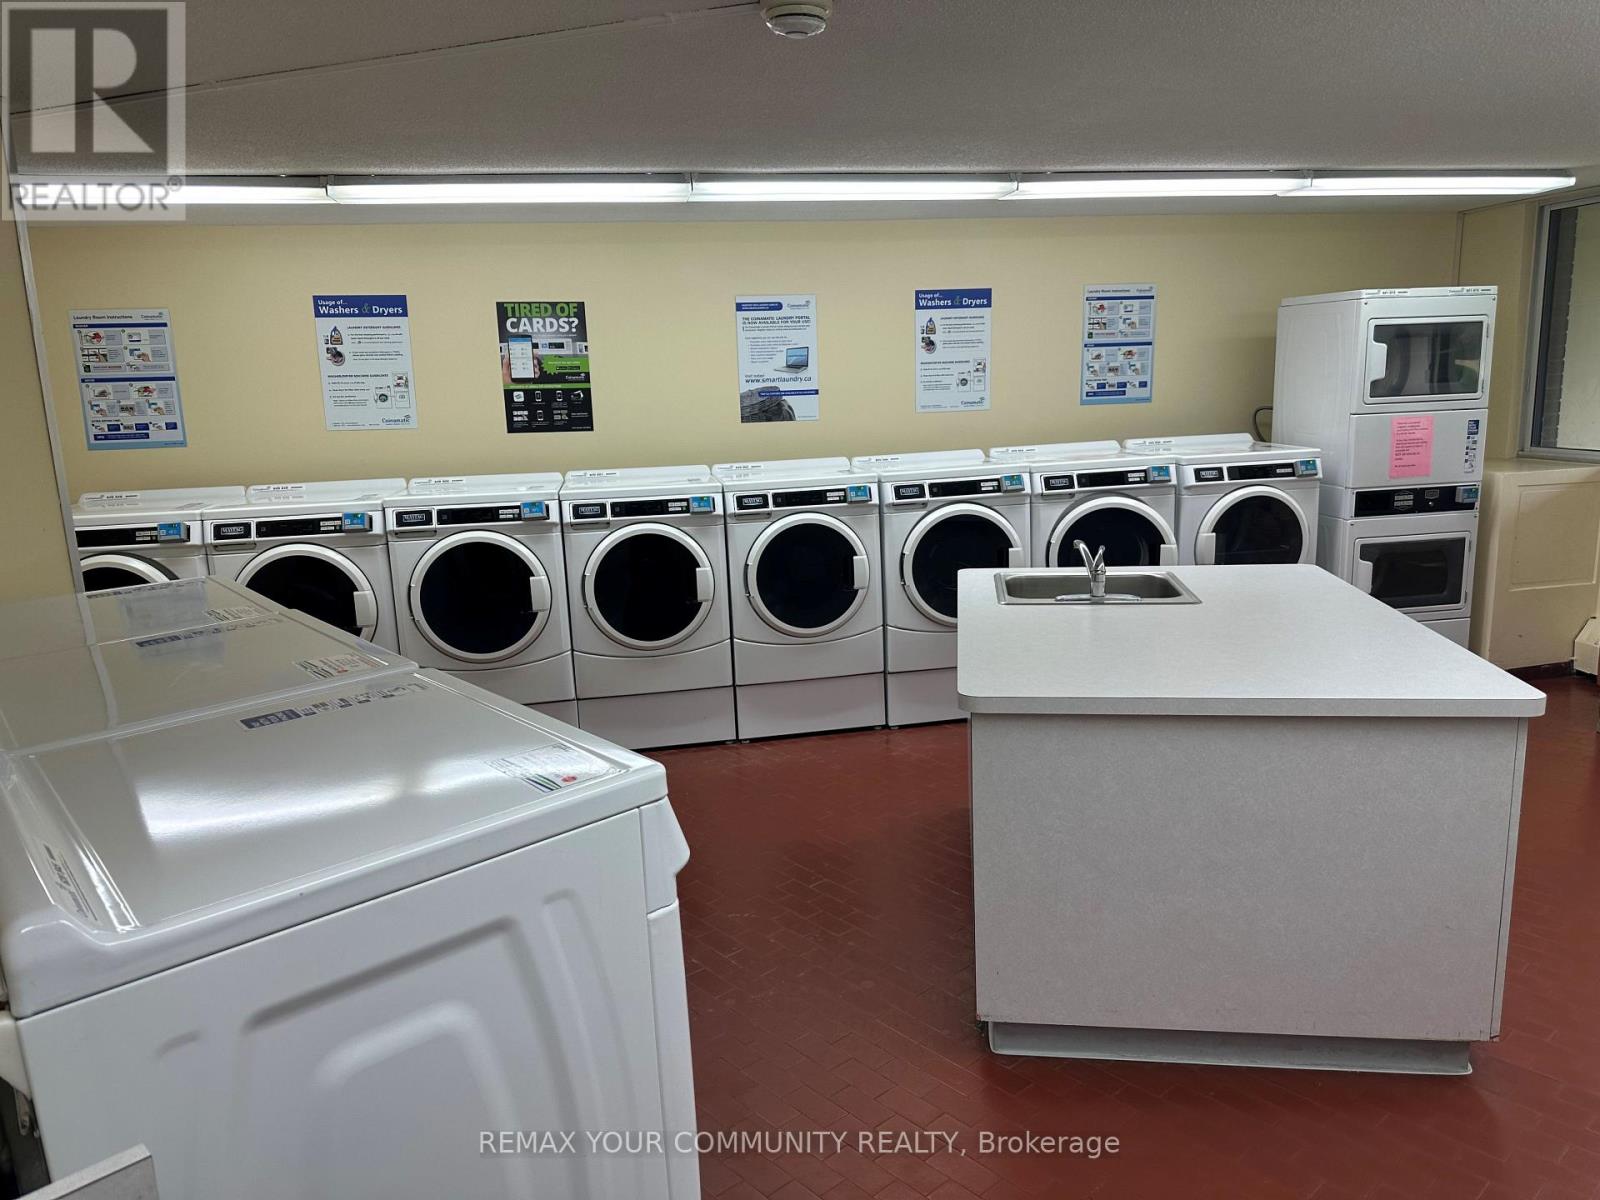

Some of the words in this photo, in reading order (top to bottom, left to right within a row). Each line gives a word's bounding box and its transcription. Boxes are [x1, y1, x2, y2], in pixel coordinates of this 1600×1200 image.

[919, 298, 952, 306] Washers
[962, 298, 988, 306] Dryers
[318, 306, 359, 314] Washers
[372, 306, 403, 315] Dryers
[504, 303, 552, 317] TIRED
[556, 303, 578, 317] OF
[506, 317, 578, 333] CARDS?
